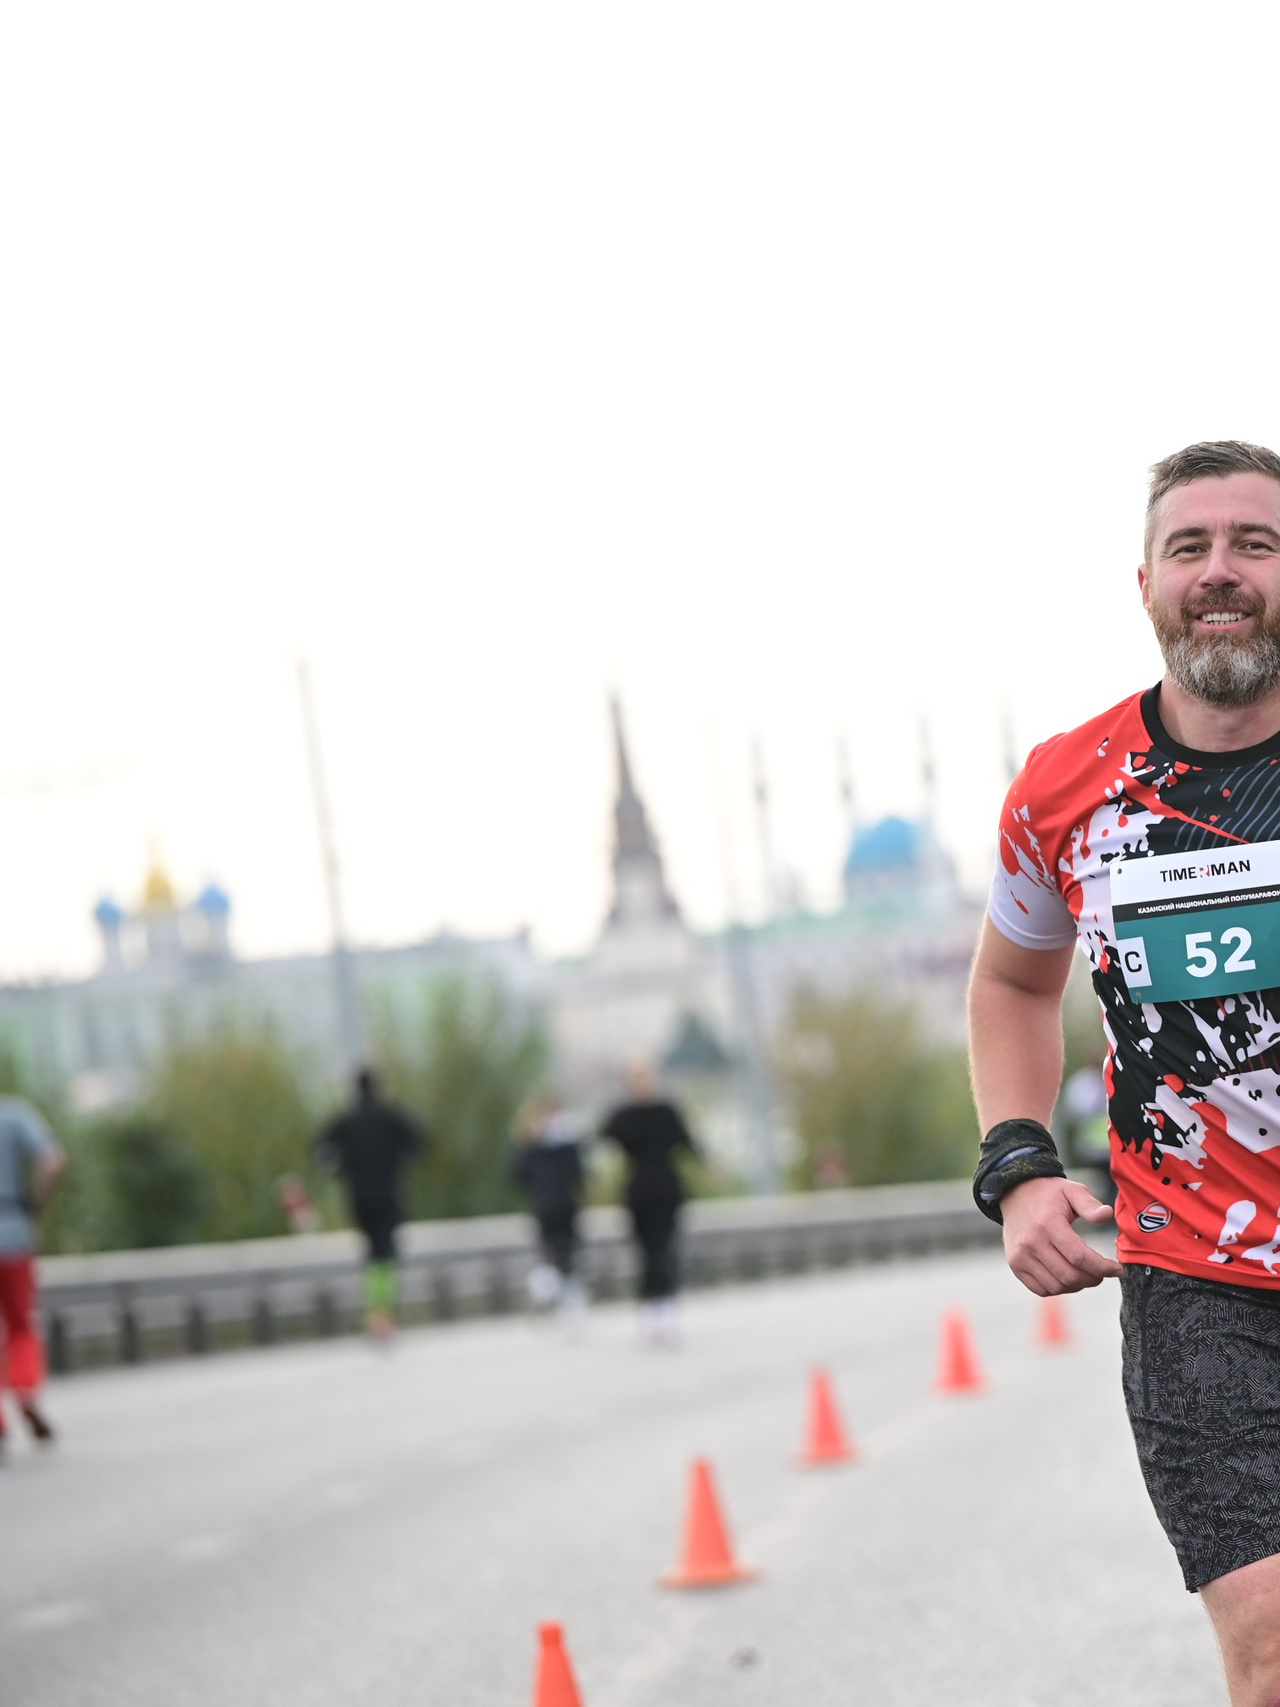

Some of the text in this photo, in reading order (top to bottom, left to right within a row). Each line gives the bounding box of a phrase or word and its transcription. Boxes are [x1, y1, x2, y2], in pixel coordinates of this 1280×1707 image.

[1137, 903, 1175, 914] КАЗАНСКИЙ
[1175, 896, 1230, 909] НАЦИОНАЛЬНЫЙ
[1185, 926, 1256, 978] 52
